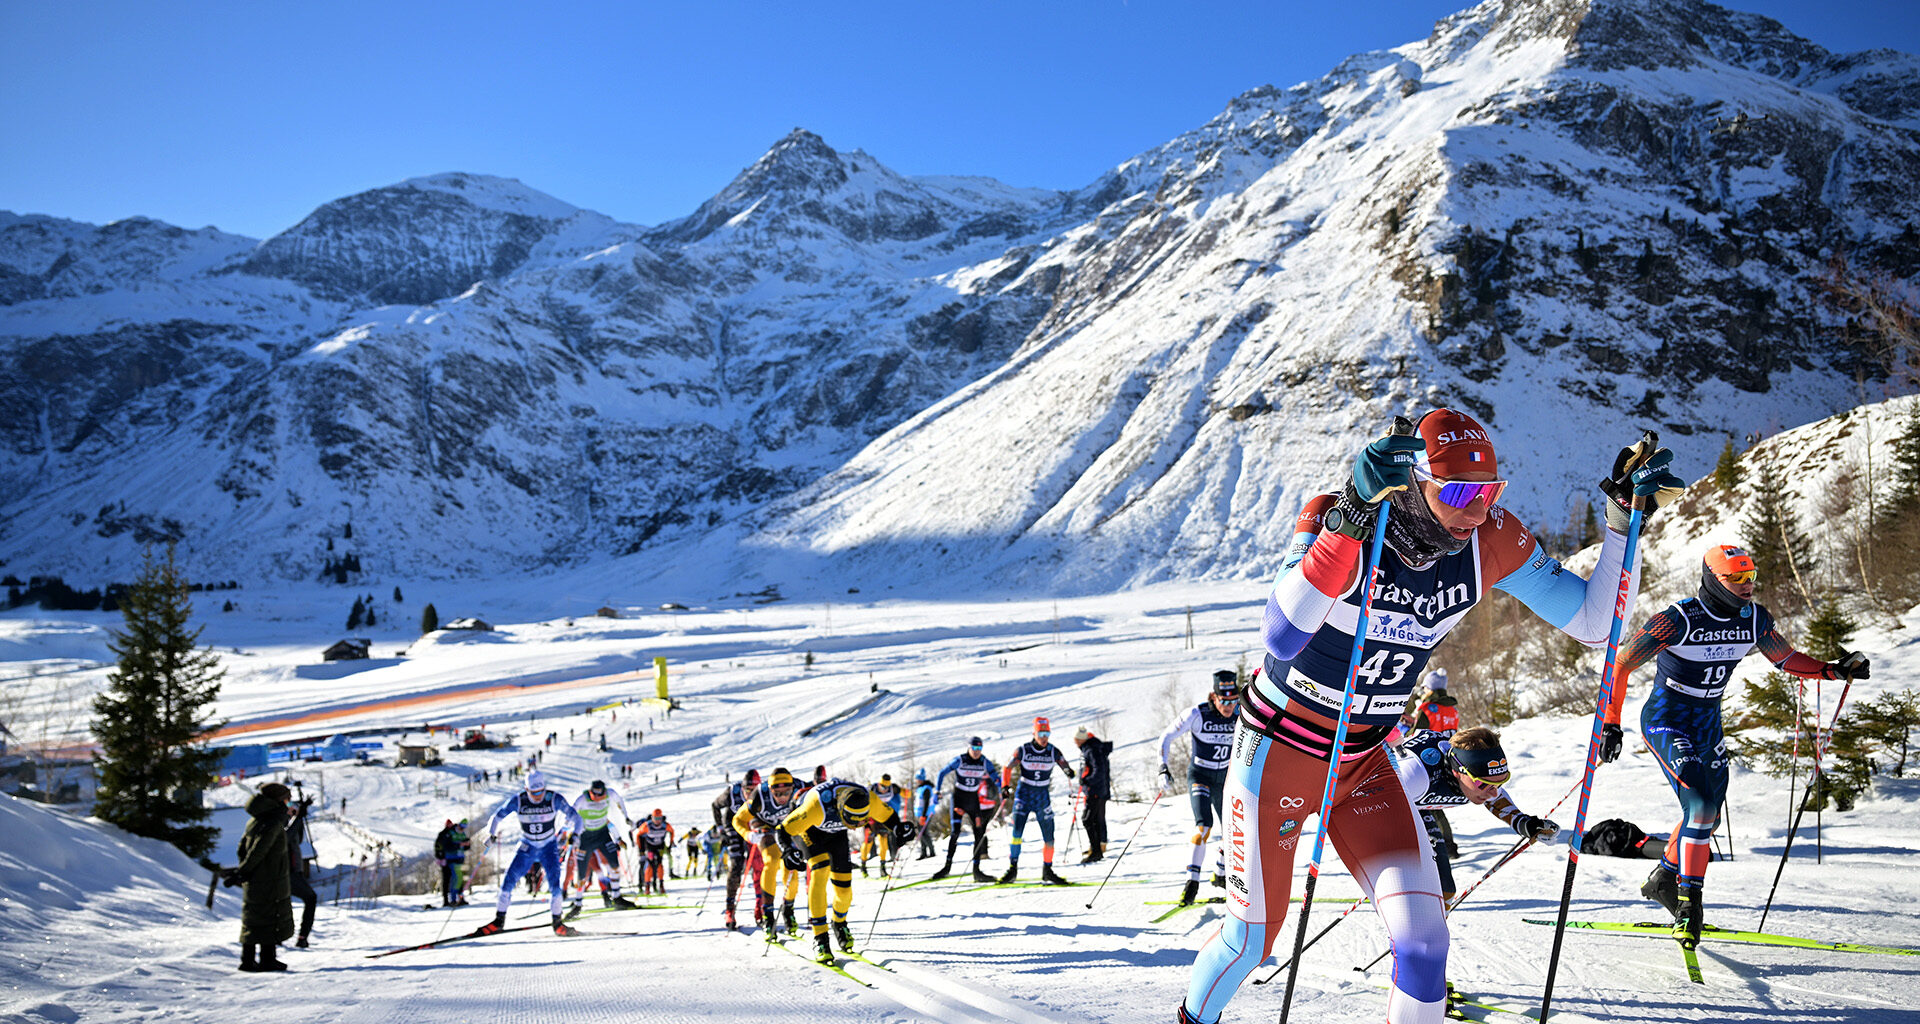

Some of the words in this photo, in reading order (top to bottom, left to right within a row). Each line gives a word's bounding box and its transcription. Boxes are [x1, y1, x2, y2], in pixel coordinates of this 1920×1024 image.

[1688, 625, 1752, 643] Gastein
[1357, 649, 1414, 686] 43
[1700, 665, 1727, 685] 19
[1293, 679, 1320, 699] STS
[1212, 745, 1229, 760] 20
[1034, 771, 1041, 780] 5
[1353, 801, 1390, 815] VEDOVA
[529, 822, 543, 833] 83
[1231, 795, 1245, 873] SLAVIA
